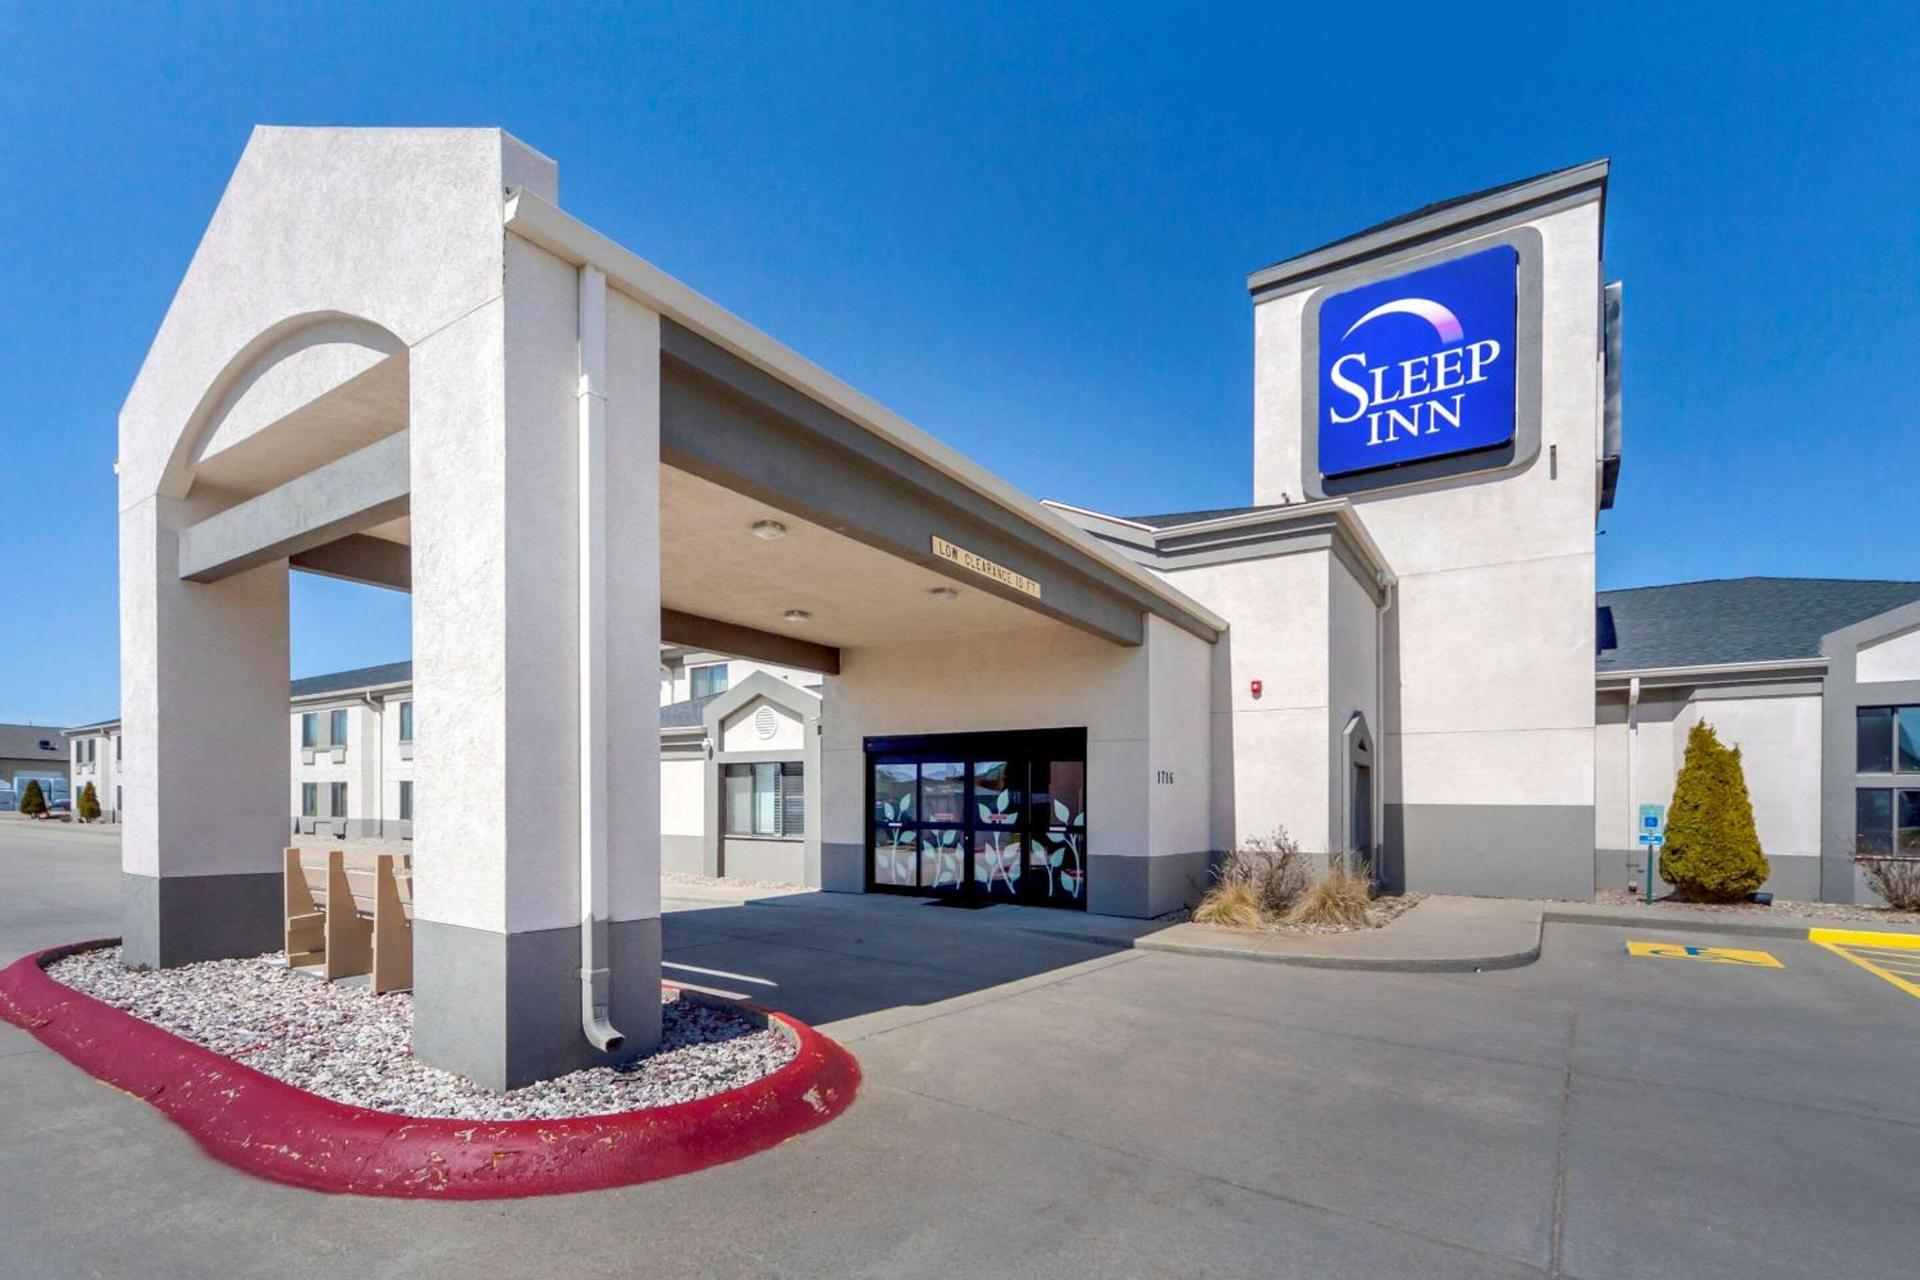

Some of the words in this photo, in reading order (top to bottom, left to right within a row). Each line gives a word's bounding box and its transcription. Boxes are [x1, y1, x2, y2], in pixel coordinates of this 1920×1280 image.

[1330, 339, 1500, 424] SLEEP
[1366, 393, 1466, 446] INN
[939, 540, 958, 561] LOW
[964, 552, 1012, 585] CLEARANCE
[1157, 770, 1174, 785] 1716
